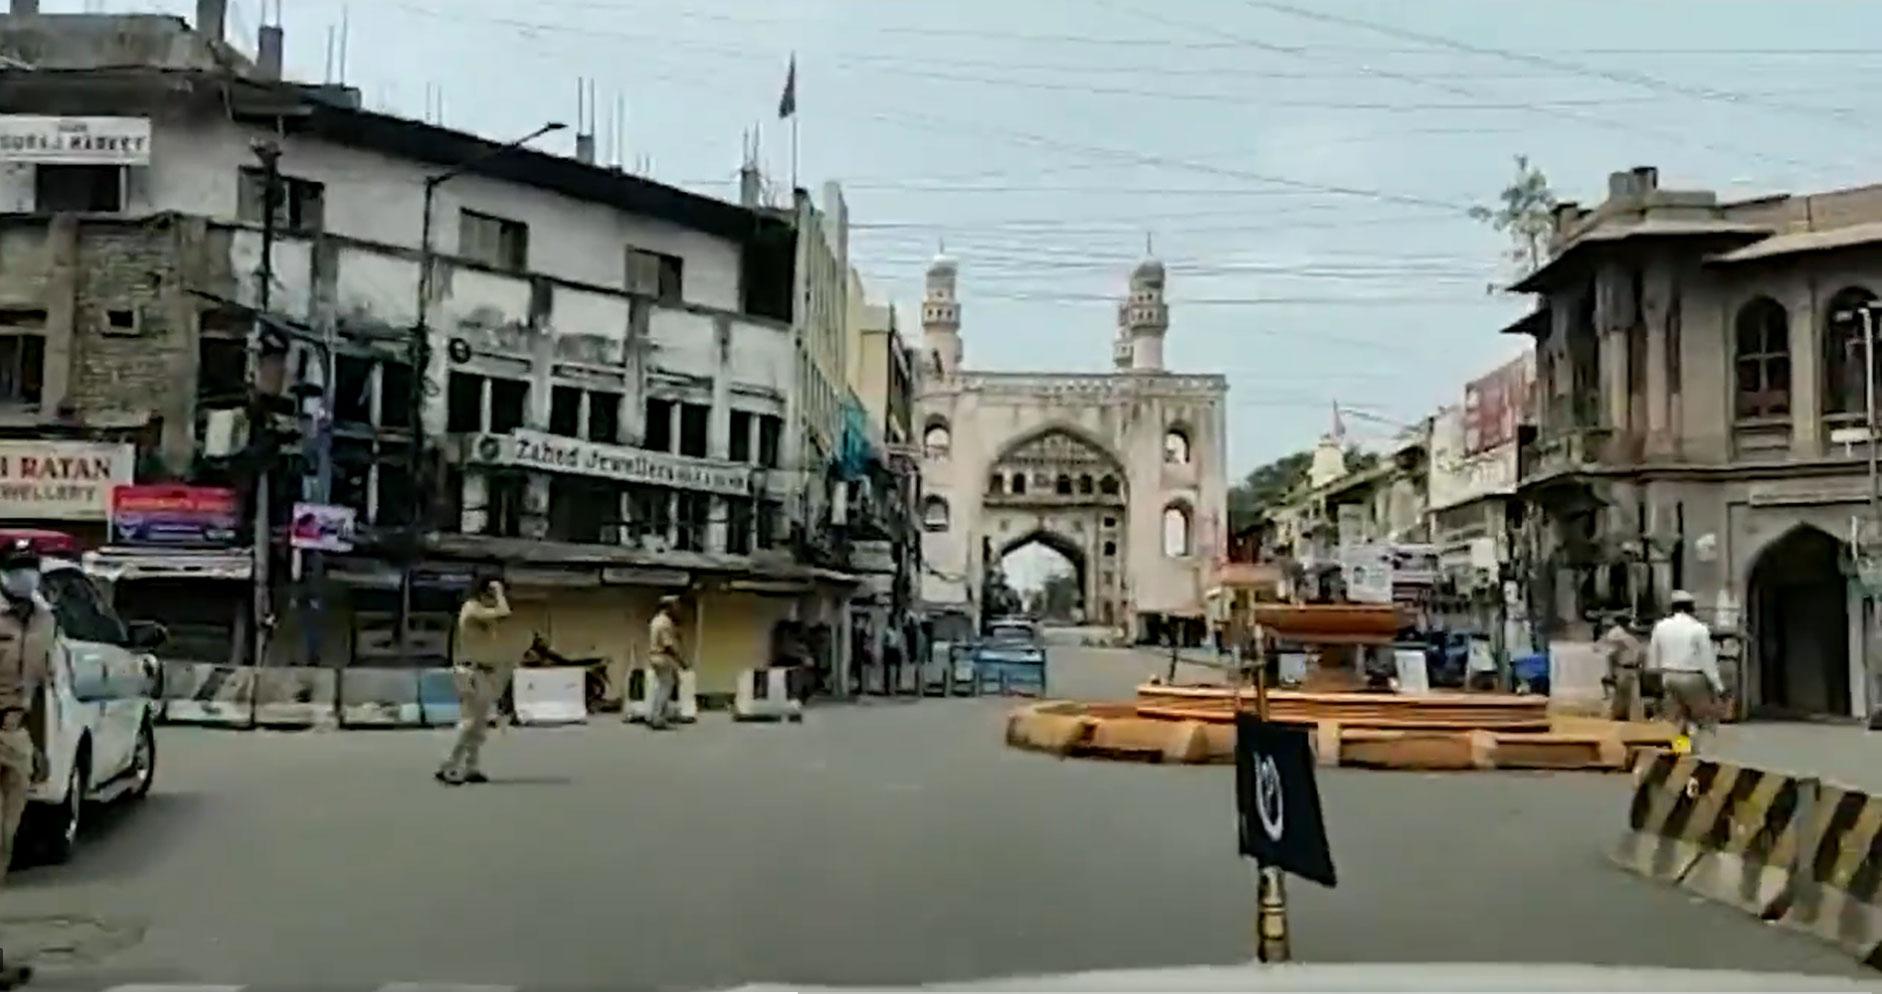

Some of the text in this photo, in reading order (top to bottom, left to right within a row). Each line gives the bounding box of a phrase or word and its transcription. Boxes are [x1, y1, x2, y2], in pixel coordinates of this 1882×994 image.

[21, 456, 112, 479] RATAN
[517, 439, 579, 468] Zahed
[585, 449, 674, 482] Jewellers
